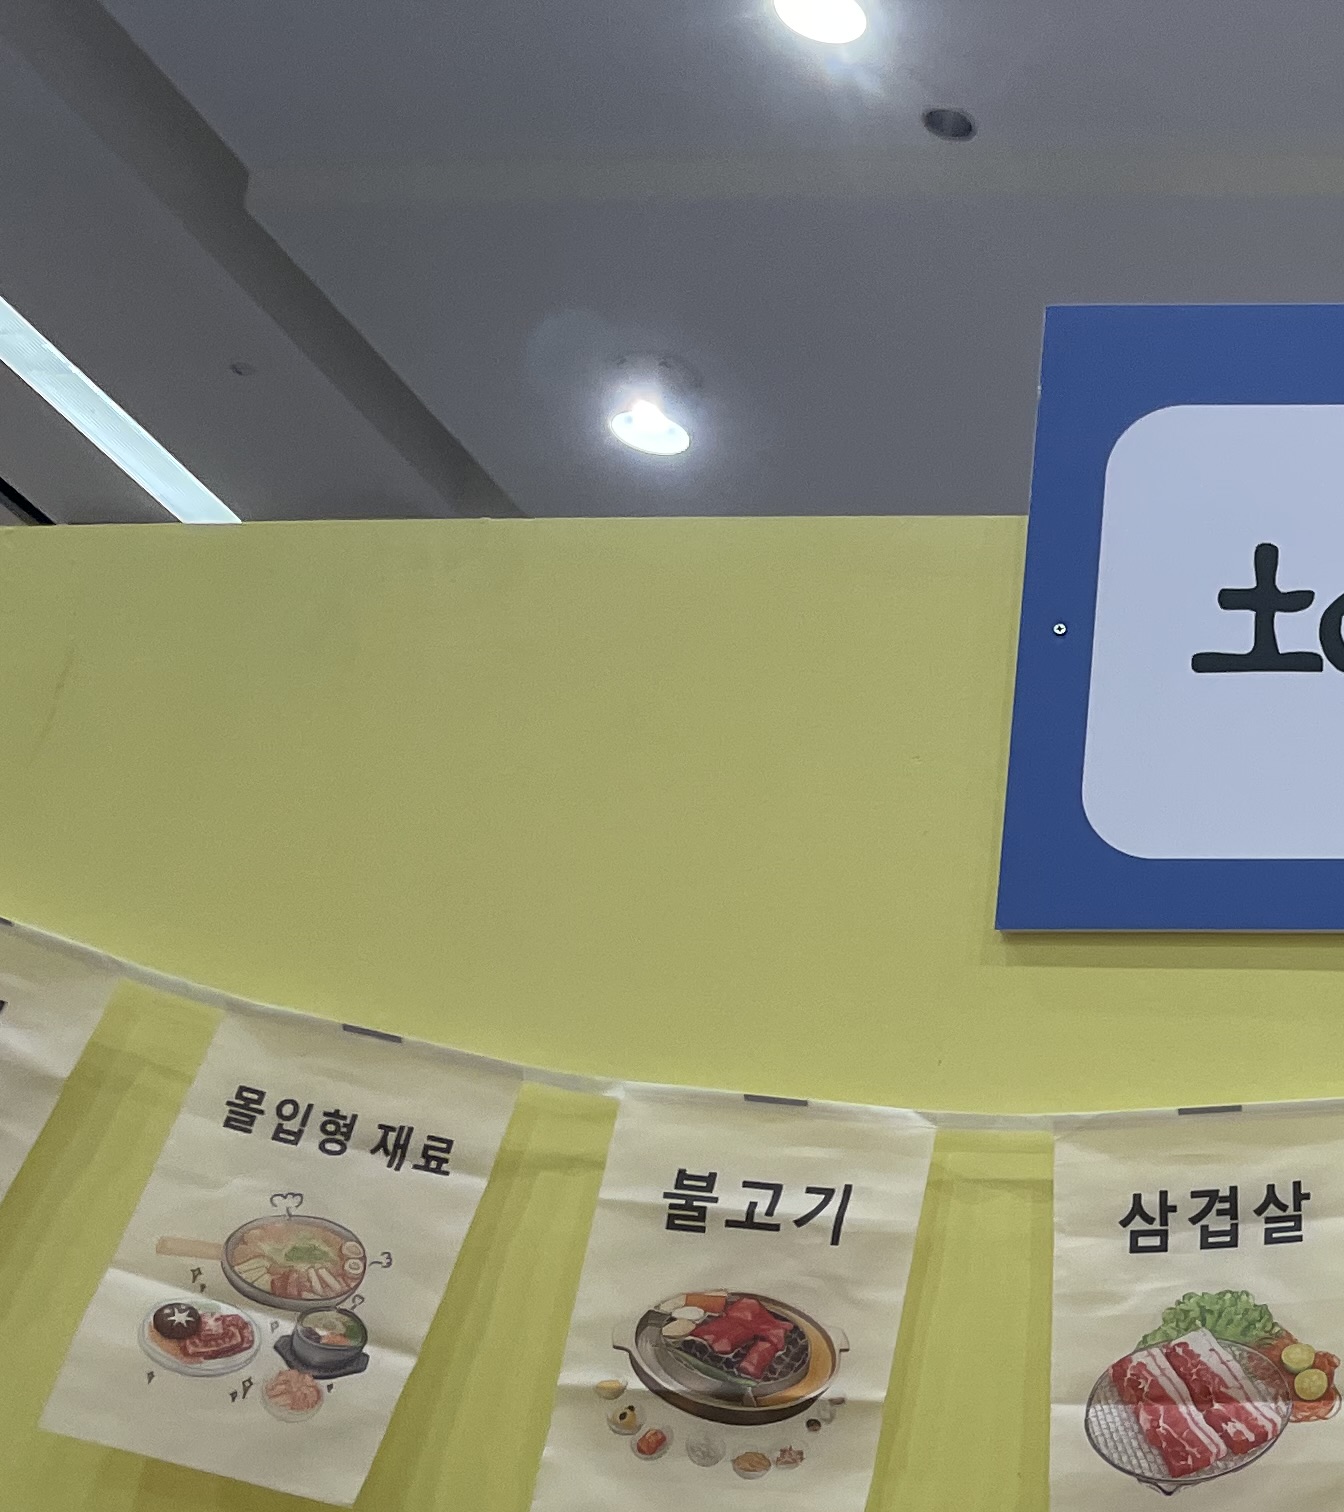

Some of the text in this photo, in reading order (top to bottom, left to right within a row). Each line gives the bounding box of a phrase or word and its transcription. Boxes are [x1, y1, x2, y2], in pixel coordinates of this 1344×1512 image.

[220, 1084, 457, 1178] 몰입형 재료
[661, 1168, 854, 1247] 불고기
[1118, 1180, 1312, 1254] 삼겹살
